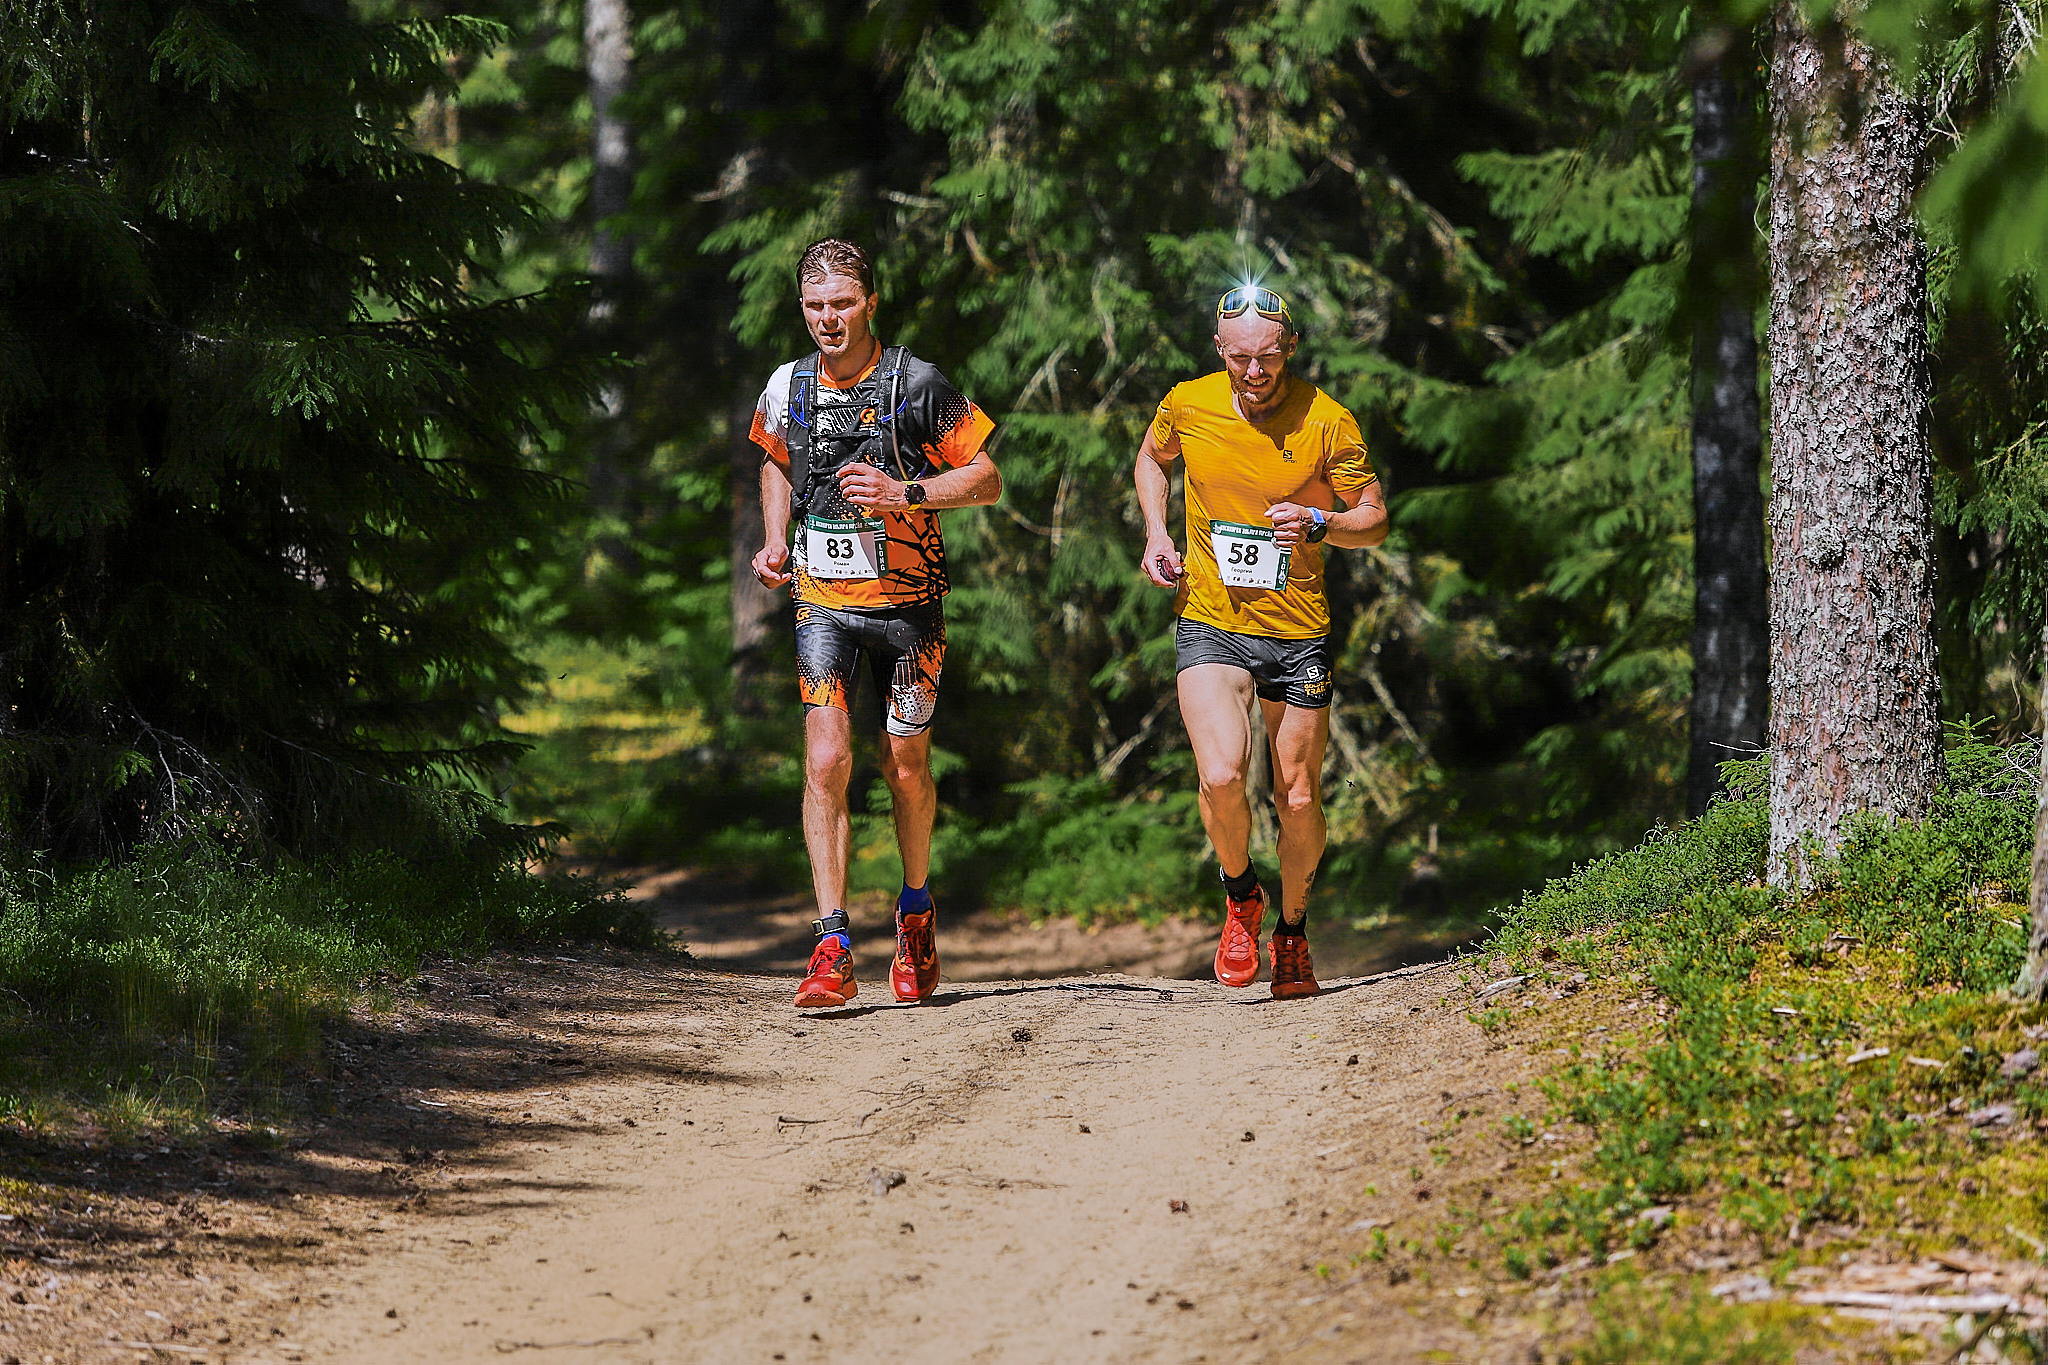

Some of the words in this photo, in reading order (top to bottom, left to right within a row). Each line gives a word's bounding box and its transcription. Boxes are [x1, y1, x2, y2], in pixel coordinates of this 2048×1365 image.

[827, 538, 854, 559] 83
[878, 543, 886, 571] LONG
[1228, 543, 1259, 566] 58
[1231, 566, 1253, 574] Георгий
